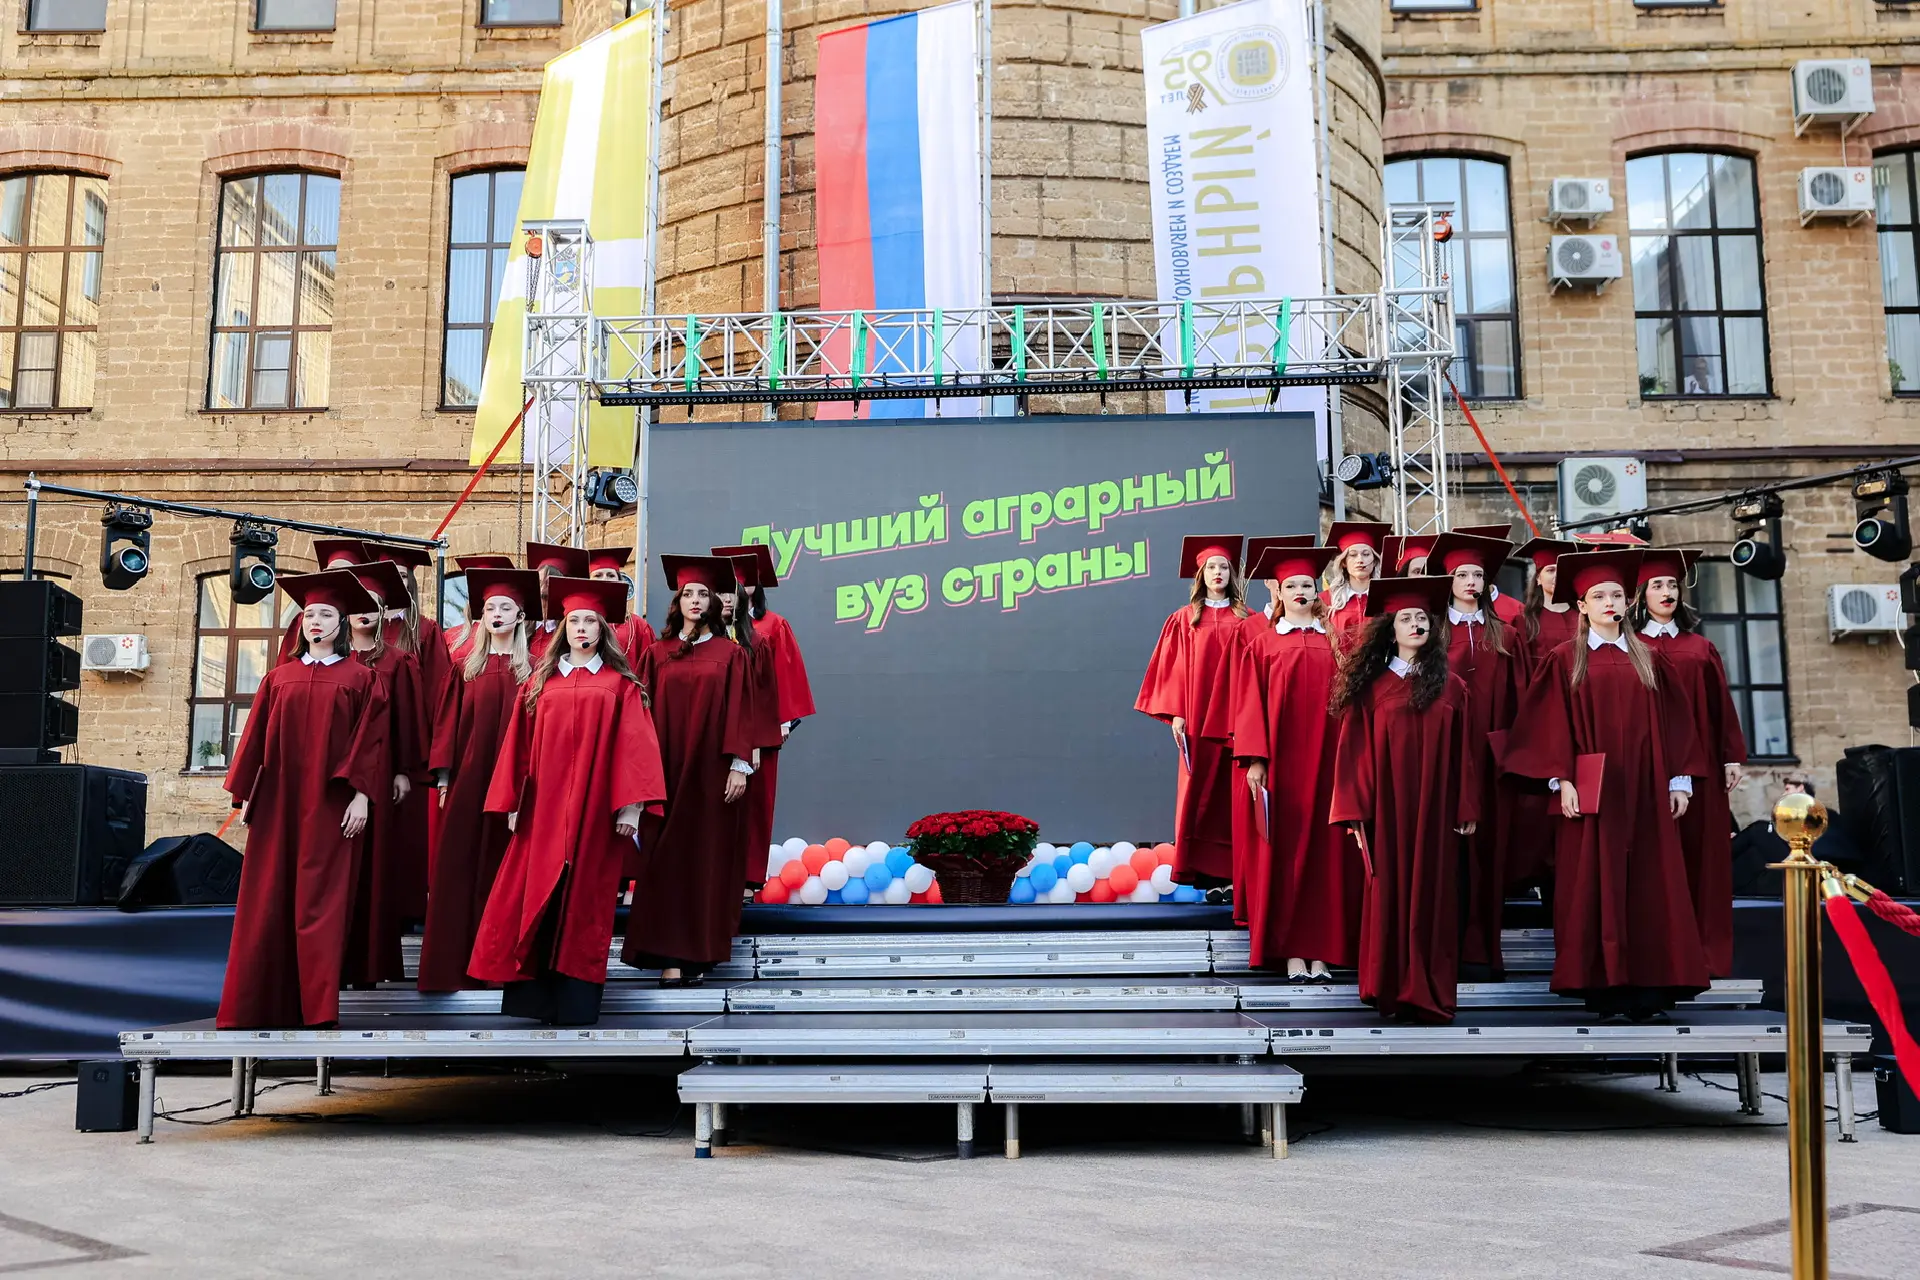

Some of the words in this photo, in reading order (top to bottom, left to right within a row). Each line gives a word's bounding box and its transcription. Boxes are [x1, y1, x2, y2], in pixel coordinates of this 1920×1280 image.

[962, 449, 1235, 545] аграрный
[835, 573, 929, 633] вуз
[941, 538, 1149, 612] страны
